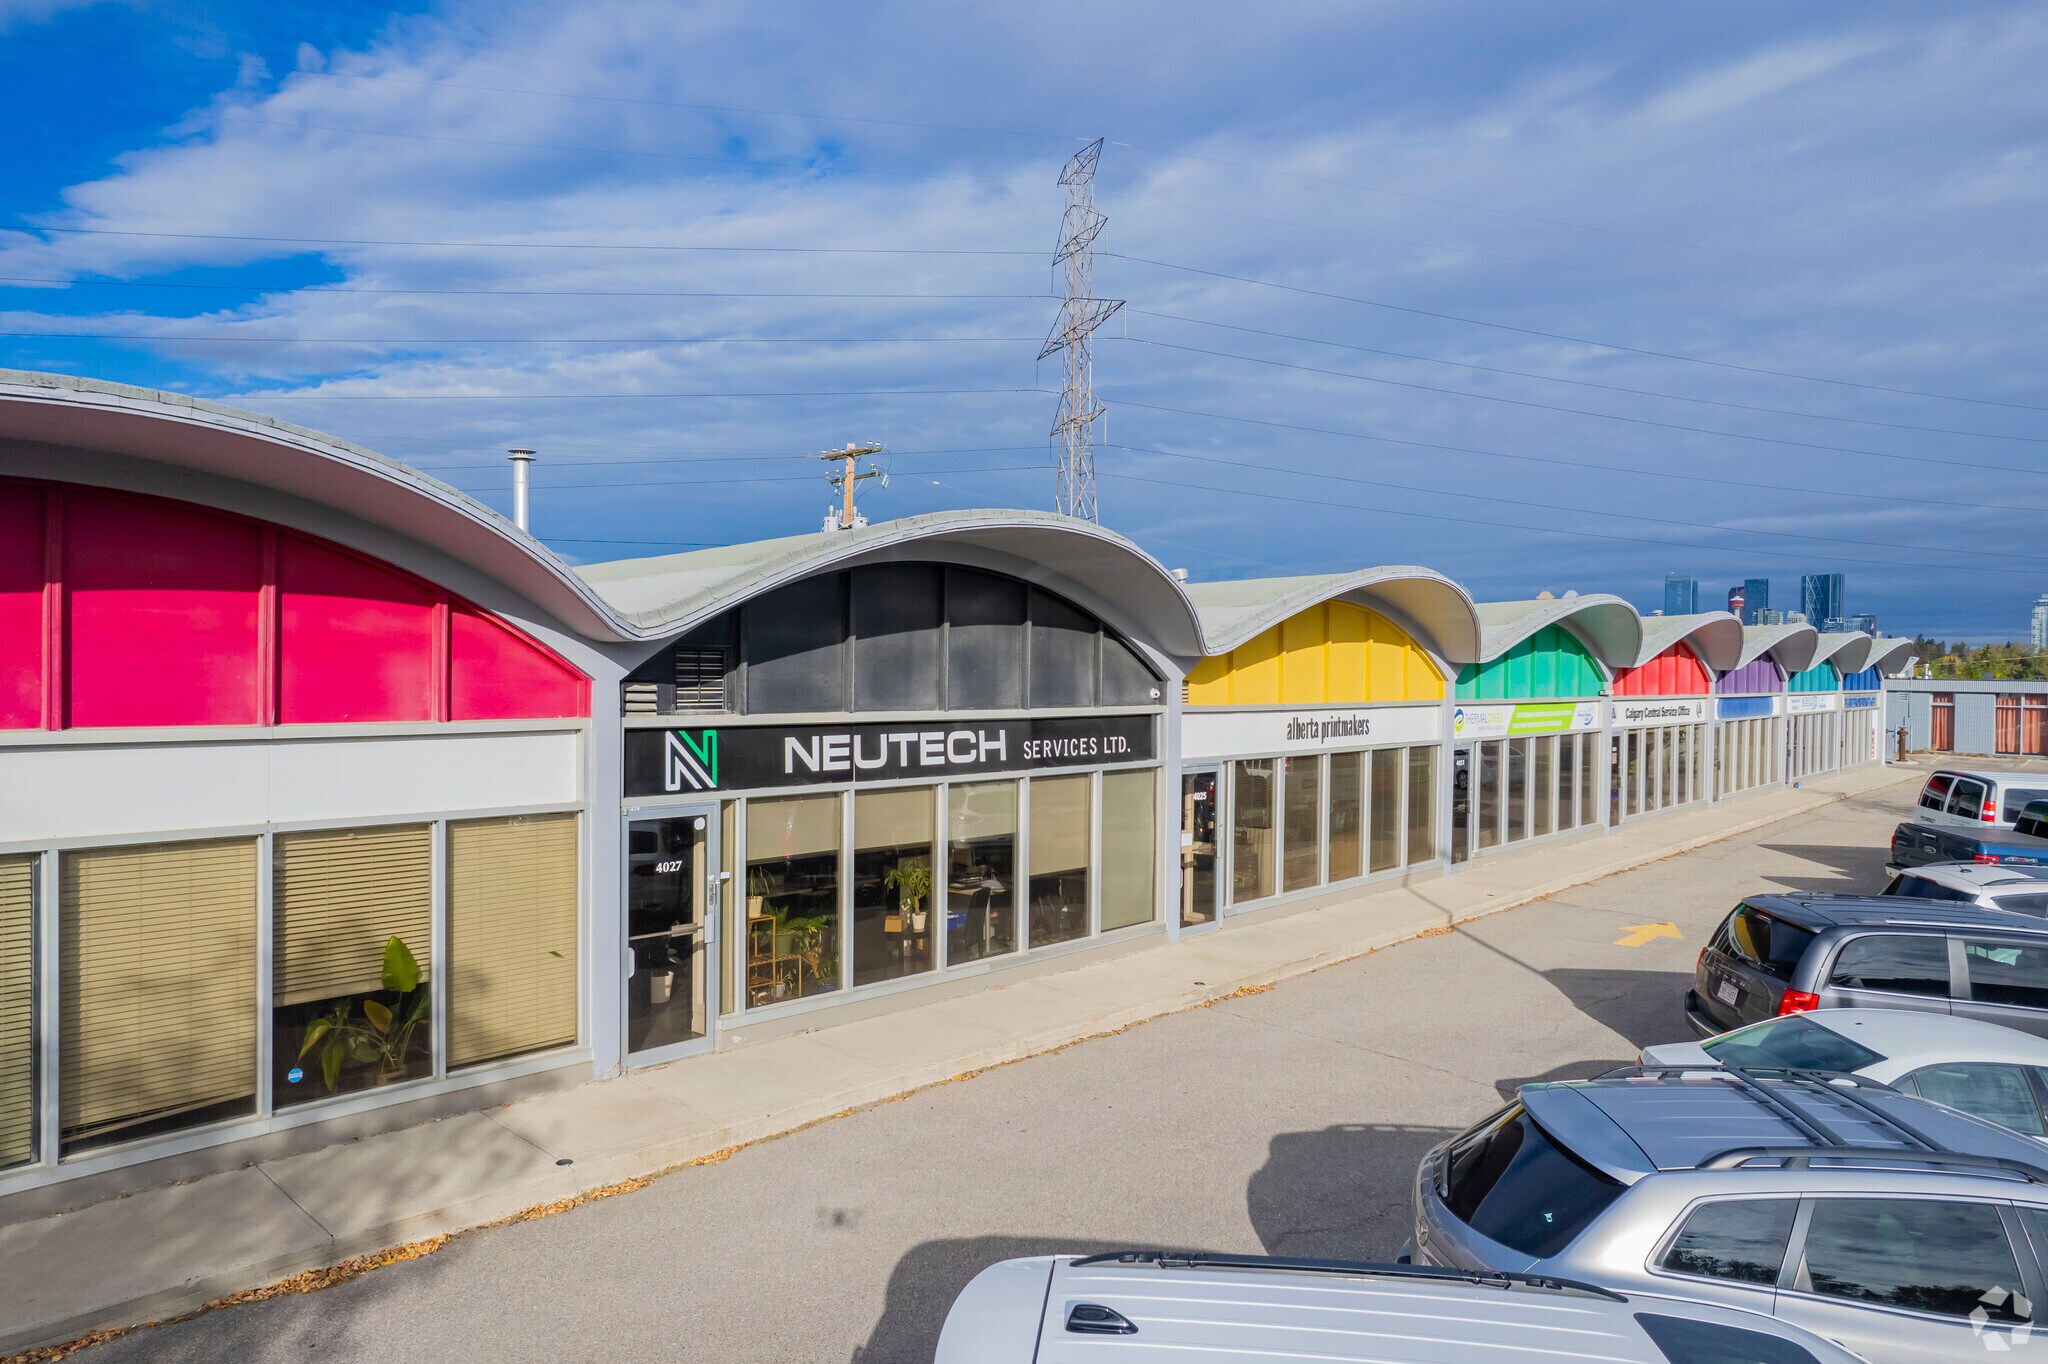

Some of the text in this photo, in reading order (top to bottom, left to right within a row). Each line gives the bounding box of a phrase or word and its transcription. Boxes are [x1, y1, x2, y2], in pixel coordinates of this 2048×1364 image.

[1625, 705, 1690, 721] Calgary Central Service Office
[1286, 713, 1370, 744] alberta printmakers
[784, 729, 1131, 774] NEUTECH SERVICES LTD.
[656, 860, 682, 873] 4027
